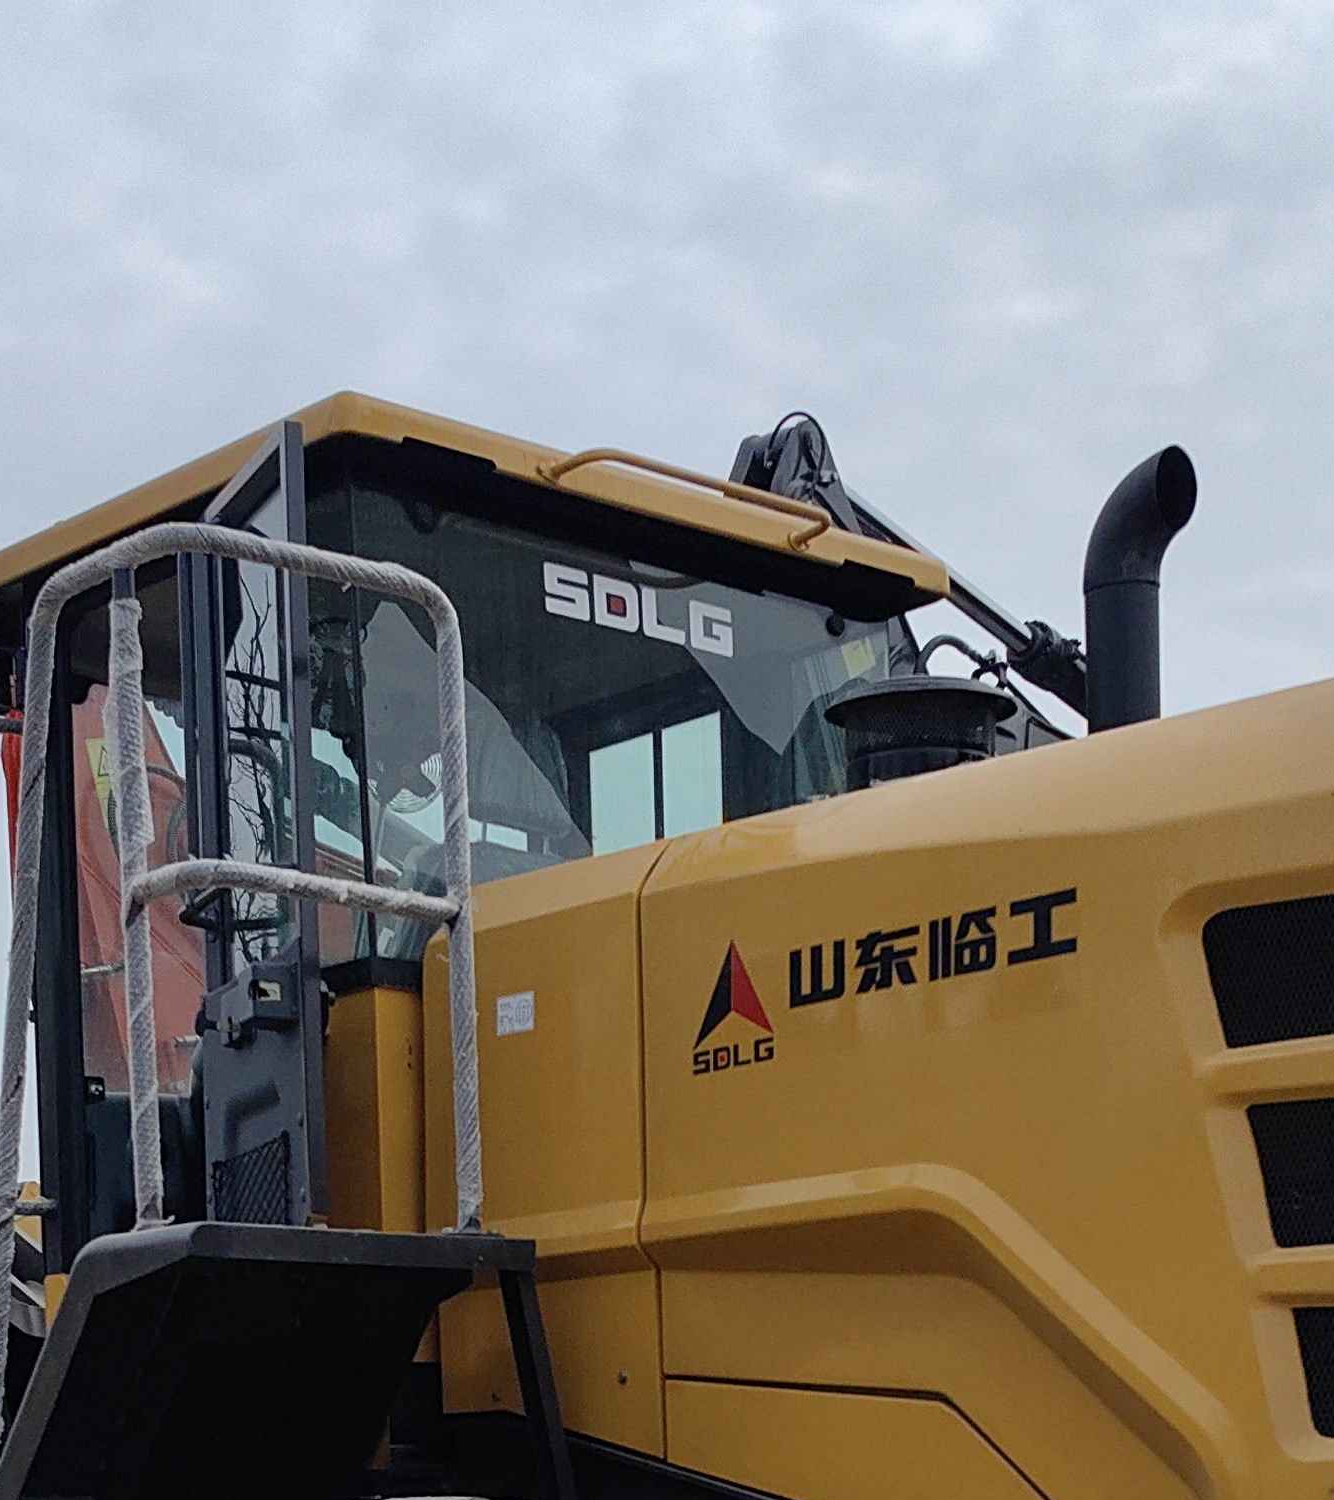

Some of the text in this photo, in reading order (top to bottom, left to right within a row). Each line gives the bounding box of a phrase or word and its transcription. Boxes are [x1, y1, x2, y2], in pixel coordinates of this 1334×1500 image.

[543, 561, 734, 658] SDLG
[789, 887, 1078, 1009] 山东临工
[693, 1037, 774, 1075] SDLG
